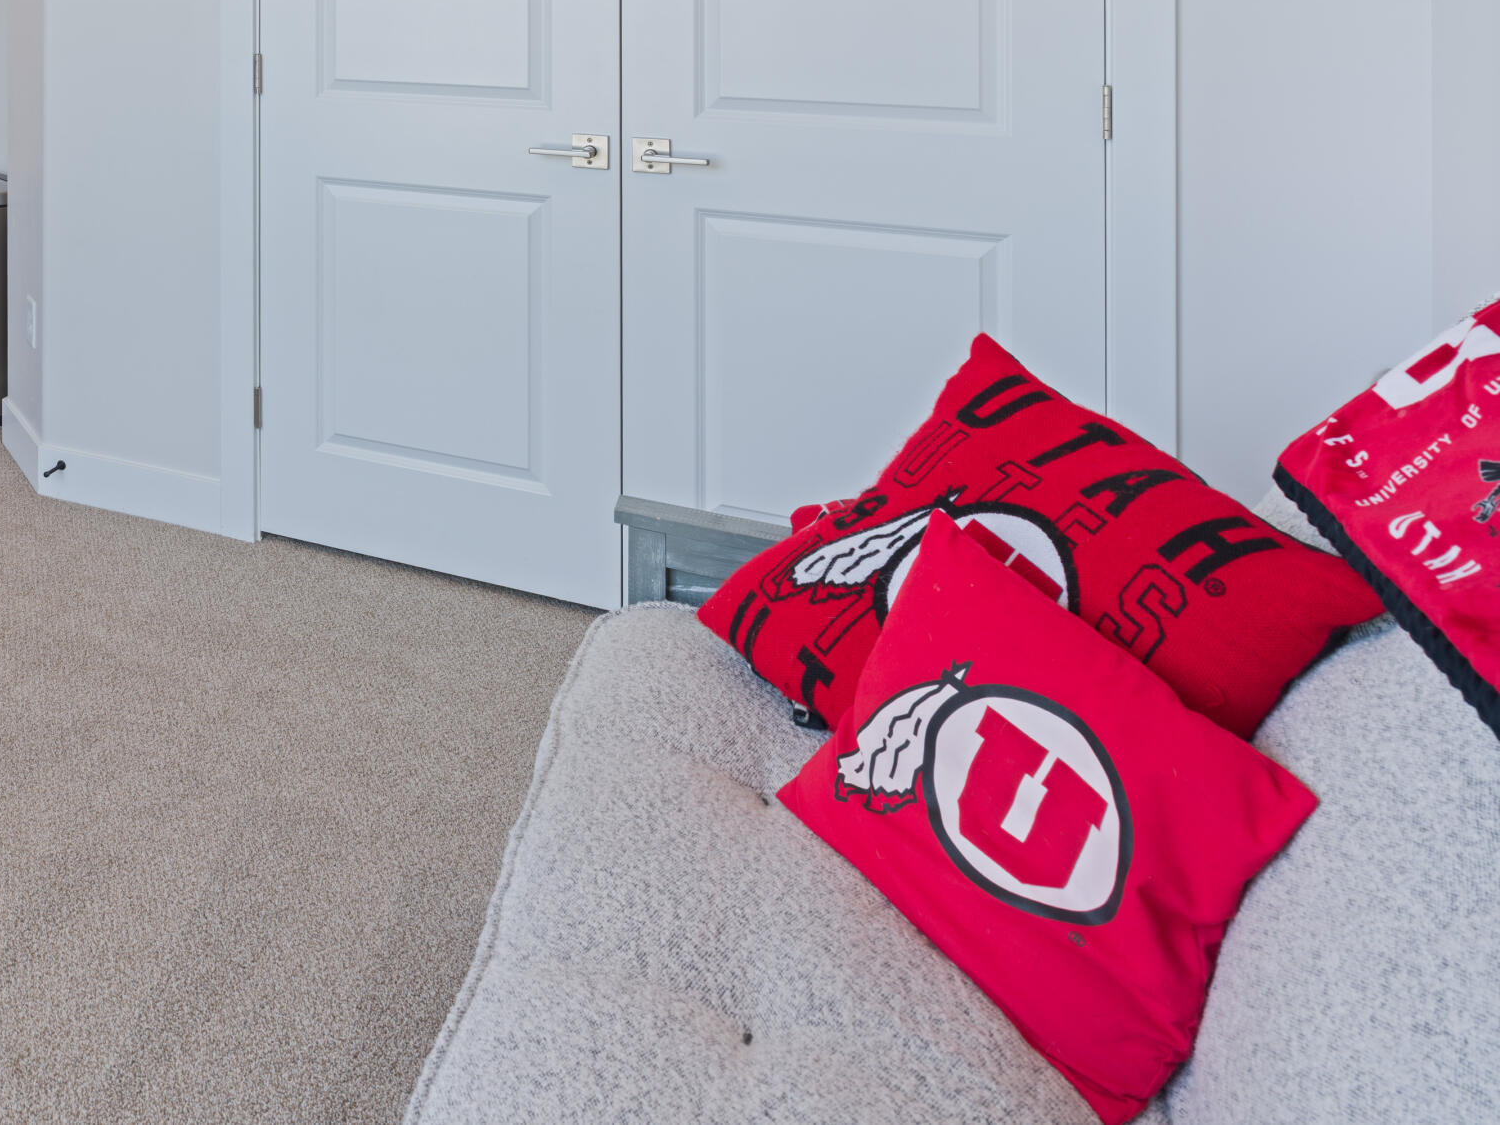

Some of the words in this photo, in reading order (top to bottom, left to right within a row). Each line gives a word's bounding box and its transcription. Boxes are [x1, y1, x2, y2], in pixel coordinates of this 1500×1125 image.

[957, 375, 1283, 584] UTAH
[1355, 433, 1452, 507] UNIVERSITY
[1460, 403, 1483, 429] OF
[1389, 510, 1482, 586] UTAH
[957, 705, 1109, 889] U
